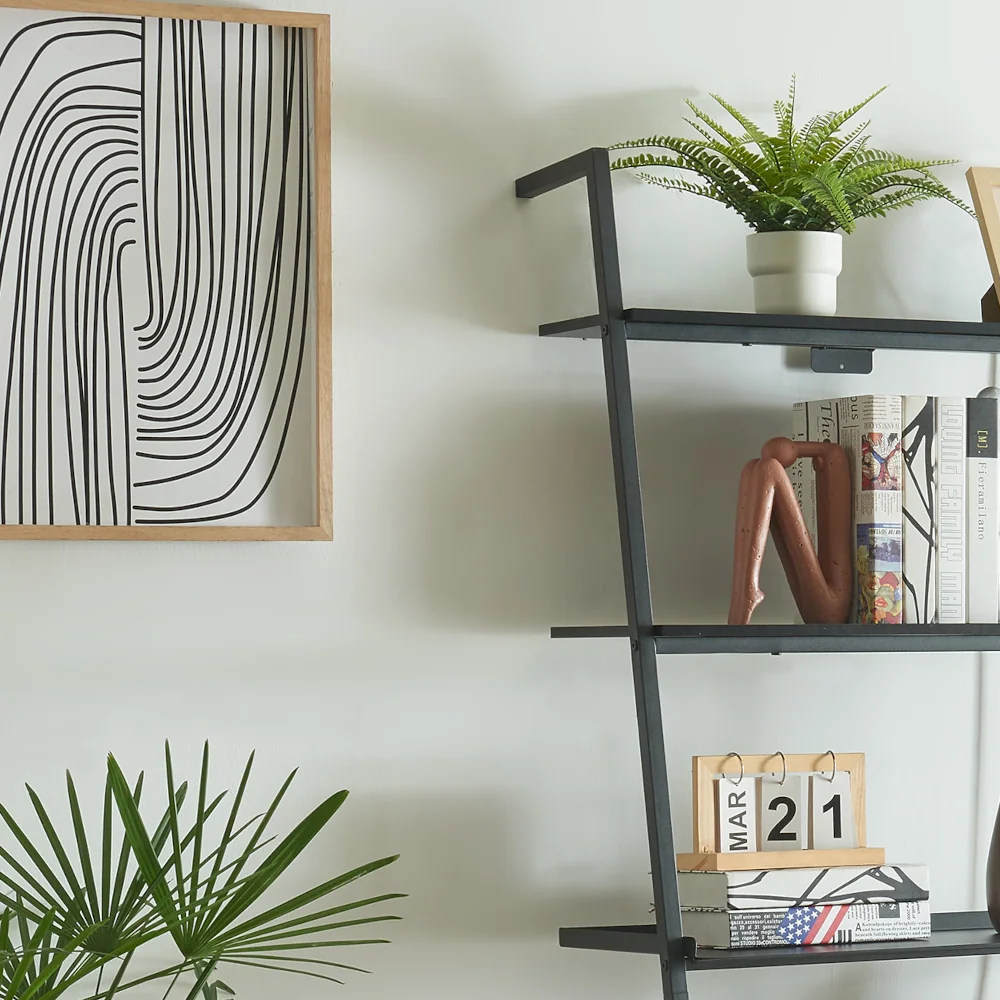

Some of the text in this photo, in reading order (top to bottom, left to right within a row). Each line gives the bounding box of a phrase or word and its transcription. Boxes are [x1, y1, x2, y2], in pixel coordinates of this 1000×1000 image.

[820, 402, 836, 439] The
[940, 484, 962, 561] FAMILY
[977, 462, 987, 540] Fieramilano
[940, 571, 962, 618] MAN
[728, 790, 842, 851] MAR 2 1
